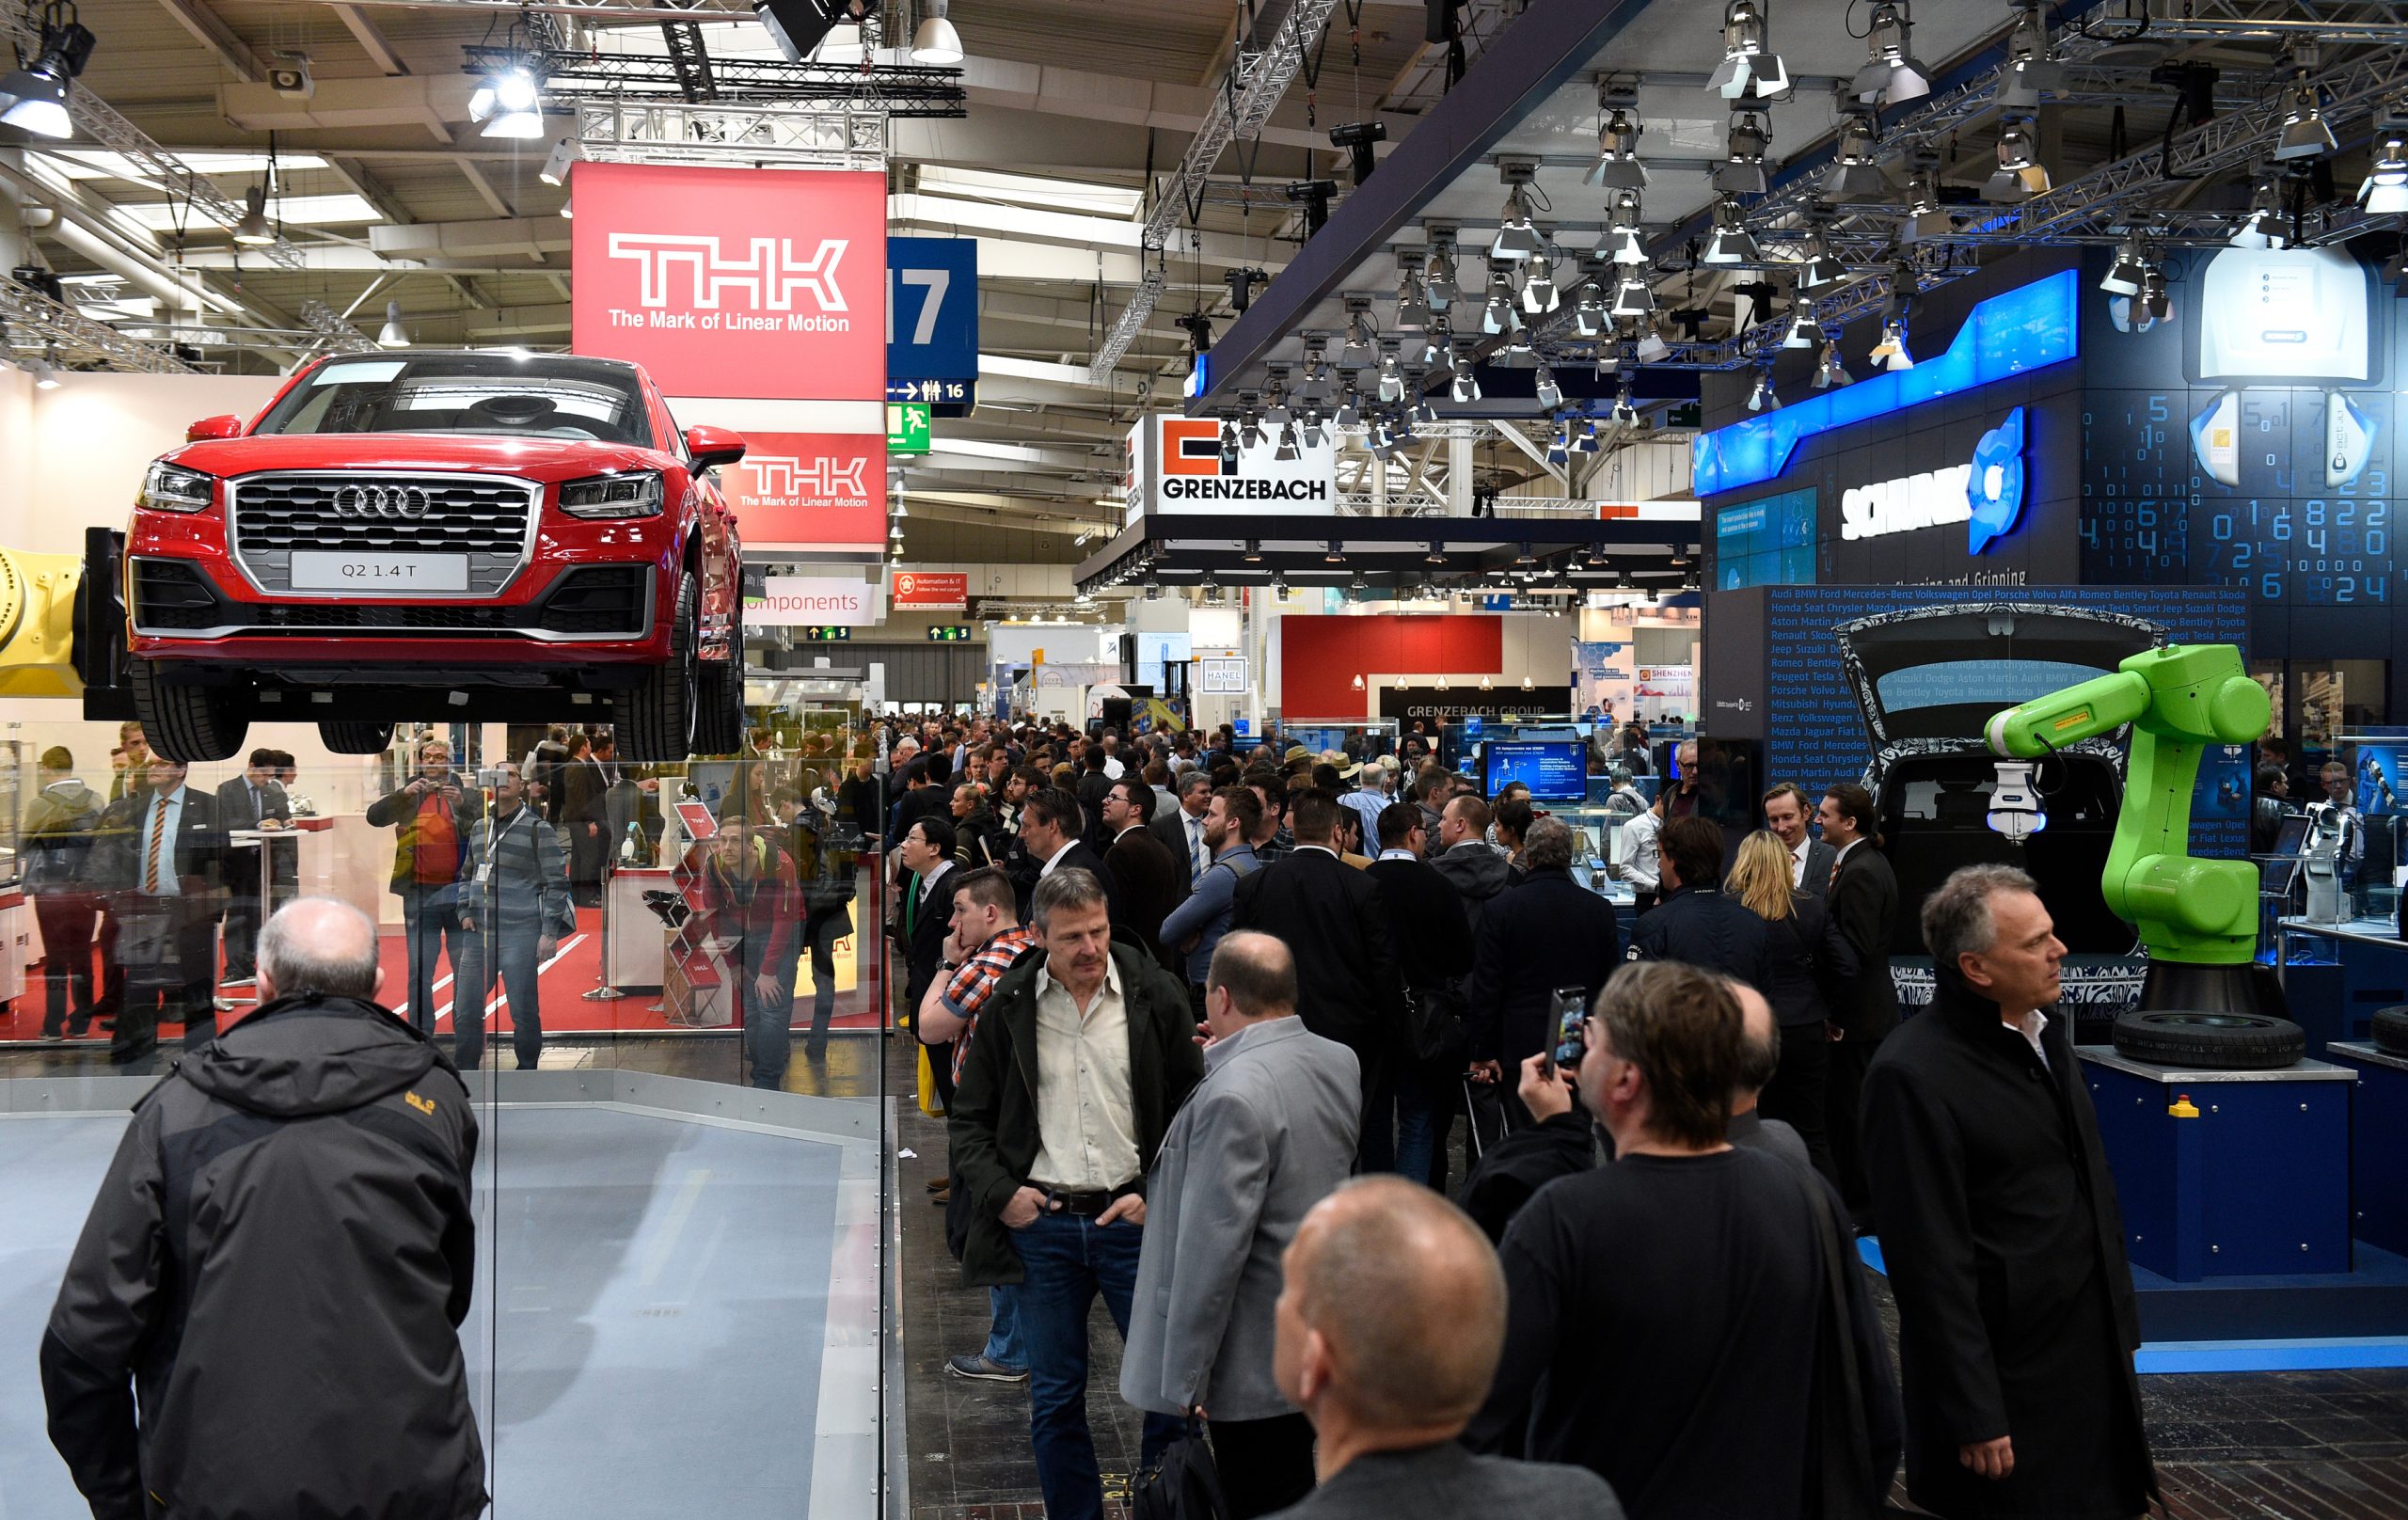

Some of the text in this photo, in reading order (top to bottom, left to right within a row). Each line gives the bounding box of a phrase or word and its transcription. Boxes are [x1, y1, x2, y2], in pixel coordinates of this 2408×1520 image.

[609, 233, 849, 311] THK
[609, 309, 849, 332] The Mark of Linear Motion
[946, 384, 964, 399] 16
[740, 456, 867, 497] THK
[1164, 479, 1326, 499] GRENZEBACH
[740, 496, 867, 507] The Mark of Linear Motion
[341, 564, 417, 578] Q2 1.4 T
[1771, 589, 2246, 602] Audi BMW Ford Mercedes-Benz Volkswagen Opel Porsche Volvo Alfa Romeo Bentley Toyota Renault Skoda
[1771, 603, 1801, 613] Honda
[1804, 604, 1824, 613] Seat
[1827, 603, 1862, 616] Chrysler
[1866, 603, 1895, 613] Mazda
[2109, 604, 2131, 613] Tesla
[2132, 604, 2160, 613] Smart
[2162, 604, 2182, 616] Jeep
[2185, 604, 2214, 613] Suzuki
[2217, 604, 2246, 616] Dodge
[1771, 616, 2246, 630] Aston Martin Bentley Toyota
[840, 628, 847, 637] 5
[961, 629, 968, 638] 5
[1771, 630, 1807, 641] Renault
[2194, 631, 2215, 641] Tesla
[2220, 631, 2246, 641] Smart
[1771, 645, 1792, 657] Jeep
[1796, 644, 1827, 655] Suzuki
[1771, 657, 1842, 671] Romeo Bentley
[2004, 660, 2039, 672] Chrysler
[1771, 673, 1810, 683] Peugeot
[1814, 672, 1835, 682] Tesla
[1893, 673, 1922, 684] Suzuki
[1925, 673, 1955, 686] Dodge
[1957, 673, 1985, 684] Aston
[1988, 673, 2018, 684] Martin
[2022, 673, 2042, 684] Audi
[2046, 674, 2067, 684] BMW
[1771, 686, 1836, 695] Porsche Volvo
[1896, 688, 2034, 699] Bentley Toyota Renault Skoda
[1771, 700, 1818, 709] Mitsubishi
[1407, 706, 1545, 717] GRENZEBACH GROUP
[1771, 714, 1794, 723] Benz
[1798, 713, 1853, 725] Volkswagen
[1771, 727, 1801, 736] Mazda
[1803, 727, 1834, 738] Jaguar
[1838, 727, 1856, 736] Fiat
[1771, 741, 1795, 751] BMW
[1798, 740, 1820, 751] Ford
[1771, 754, 1801, 765] Honda
[1804, 755, 1825, 765] Seat
[1827, 754, 1863, 767] Chrysler
[1771, 768, 1798, 778] Aston
[1800, 768, 1831, 778] Martin
[1834, 768, 1855, 778] Audi
[2226, 820, 2246, 831] Opel
[2200, 833, 2217, 843] Fiat
[2221, 834, 2246, 843] Lexus
